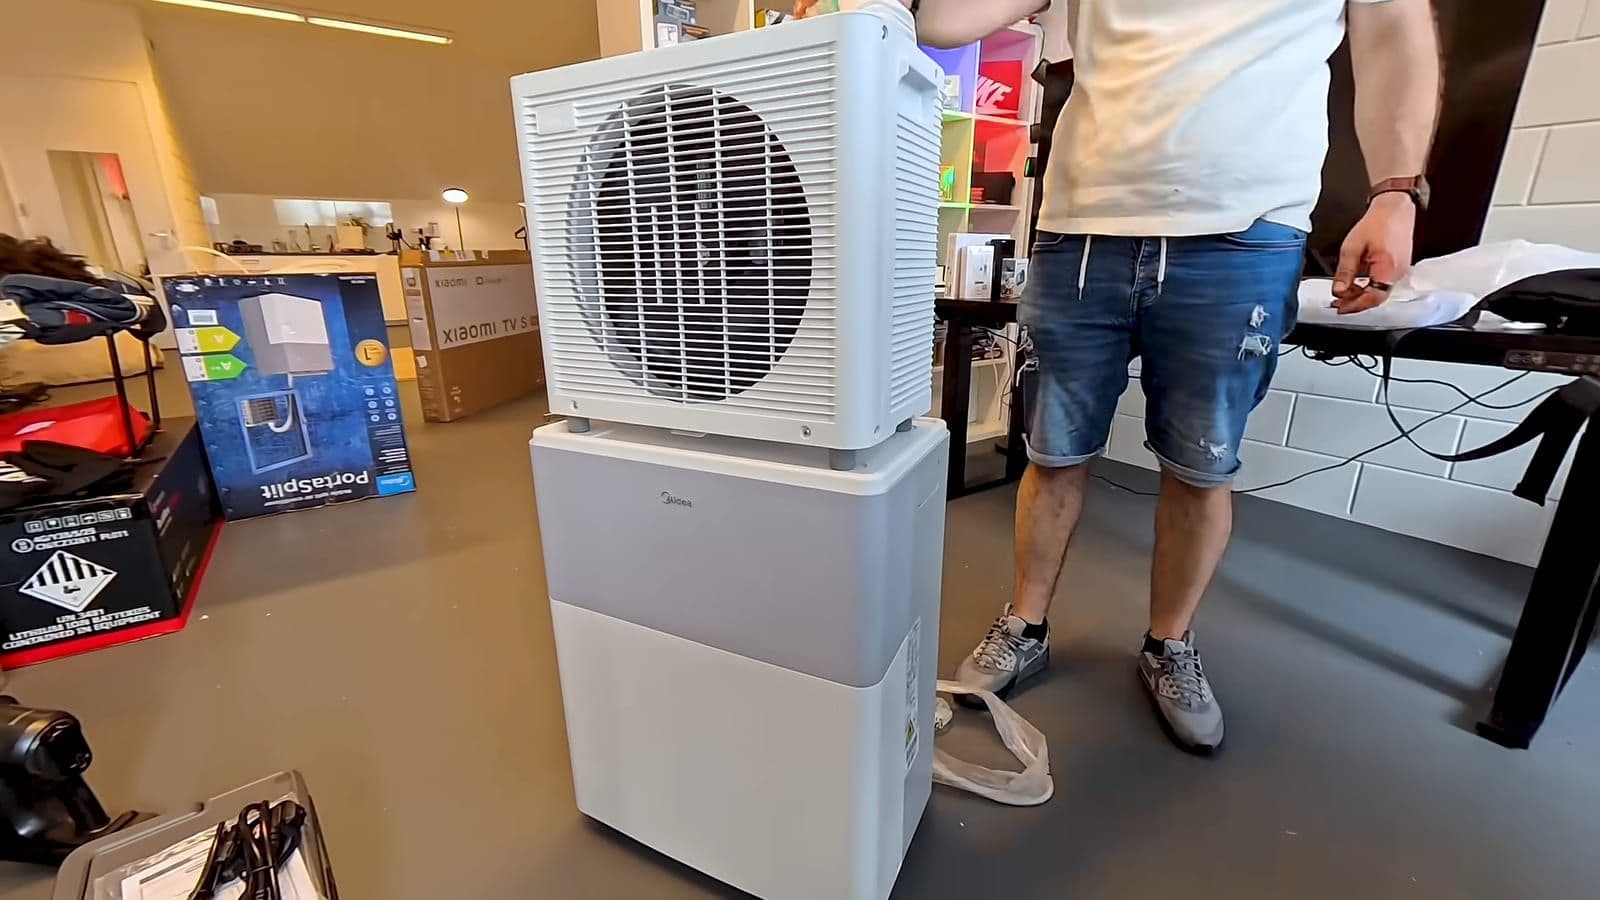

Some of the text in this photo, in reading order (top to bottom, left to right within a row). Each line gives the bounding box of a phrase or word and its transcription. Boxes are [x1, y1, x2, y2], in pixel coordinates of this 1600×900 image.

[977, 75, 1013, 107] IKE
[503, 318, 517, 332] TV
[520, 316, 528, 329] S
[260, 470, 369, 500] PortaSplit
[661, 491, 692, 508] Midea
[2, 611, 161, 650] CONTAINED IN EQUIPMENT
[9, 606, 151, 641] LITHIUM ION BATTERIES
[56, 614, 76, 623] UN
